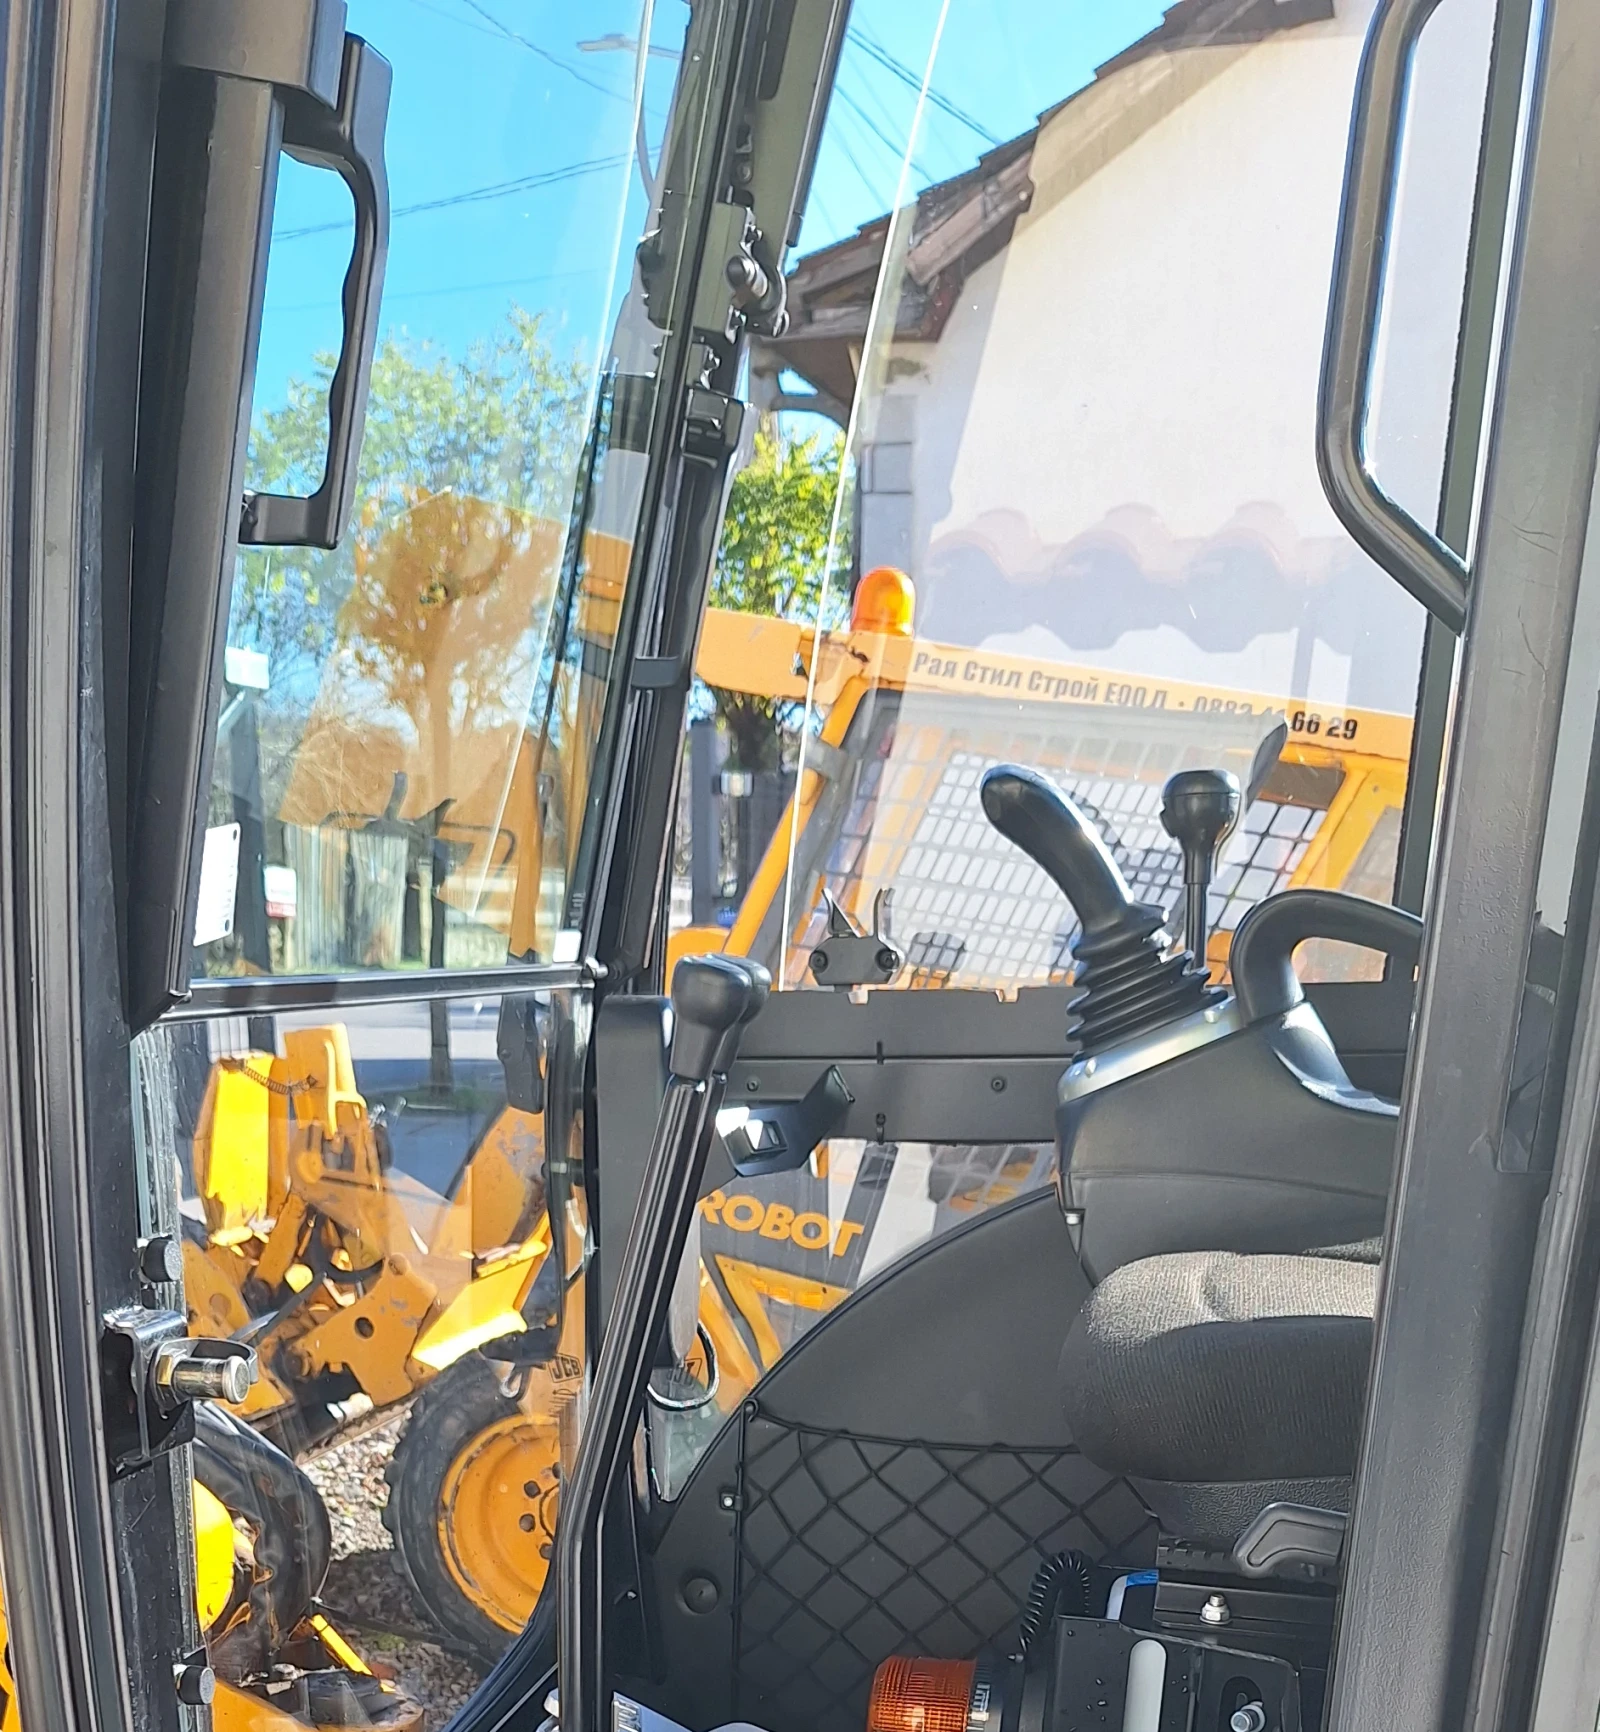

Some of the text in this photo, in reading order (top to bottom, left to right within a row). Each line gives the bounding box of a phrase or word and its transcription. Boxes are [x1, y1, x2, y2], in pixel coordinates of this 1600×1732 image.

[913, 651, 957, 678] Рая
[963, 659, 1023, 689] Стил
[1026, 670, 1099, 702] Строй
[1291, 710, 1322, 734] 66
[1325, 716, 1359, 741] 29
[697, 1188, 865, 1258] ROBOT
[552, 1354, 581, 1380] JCB
